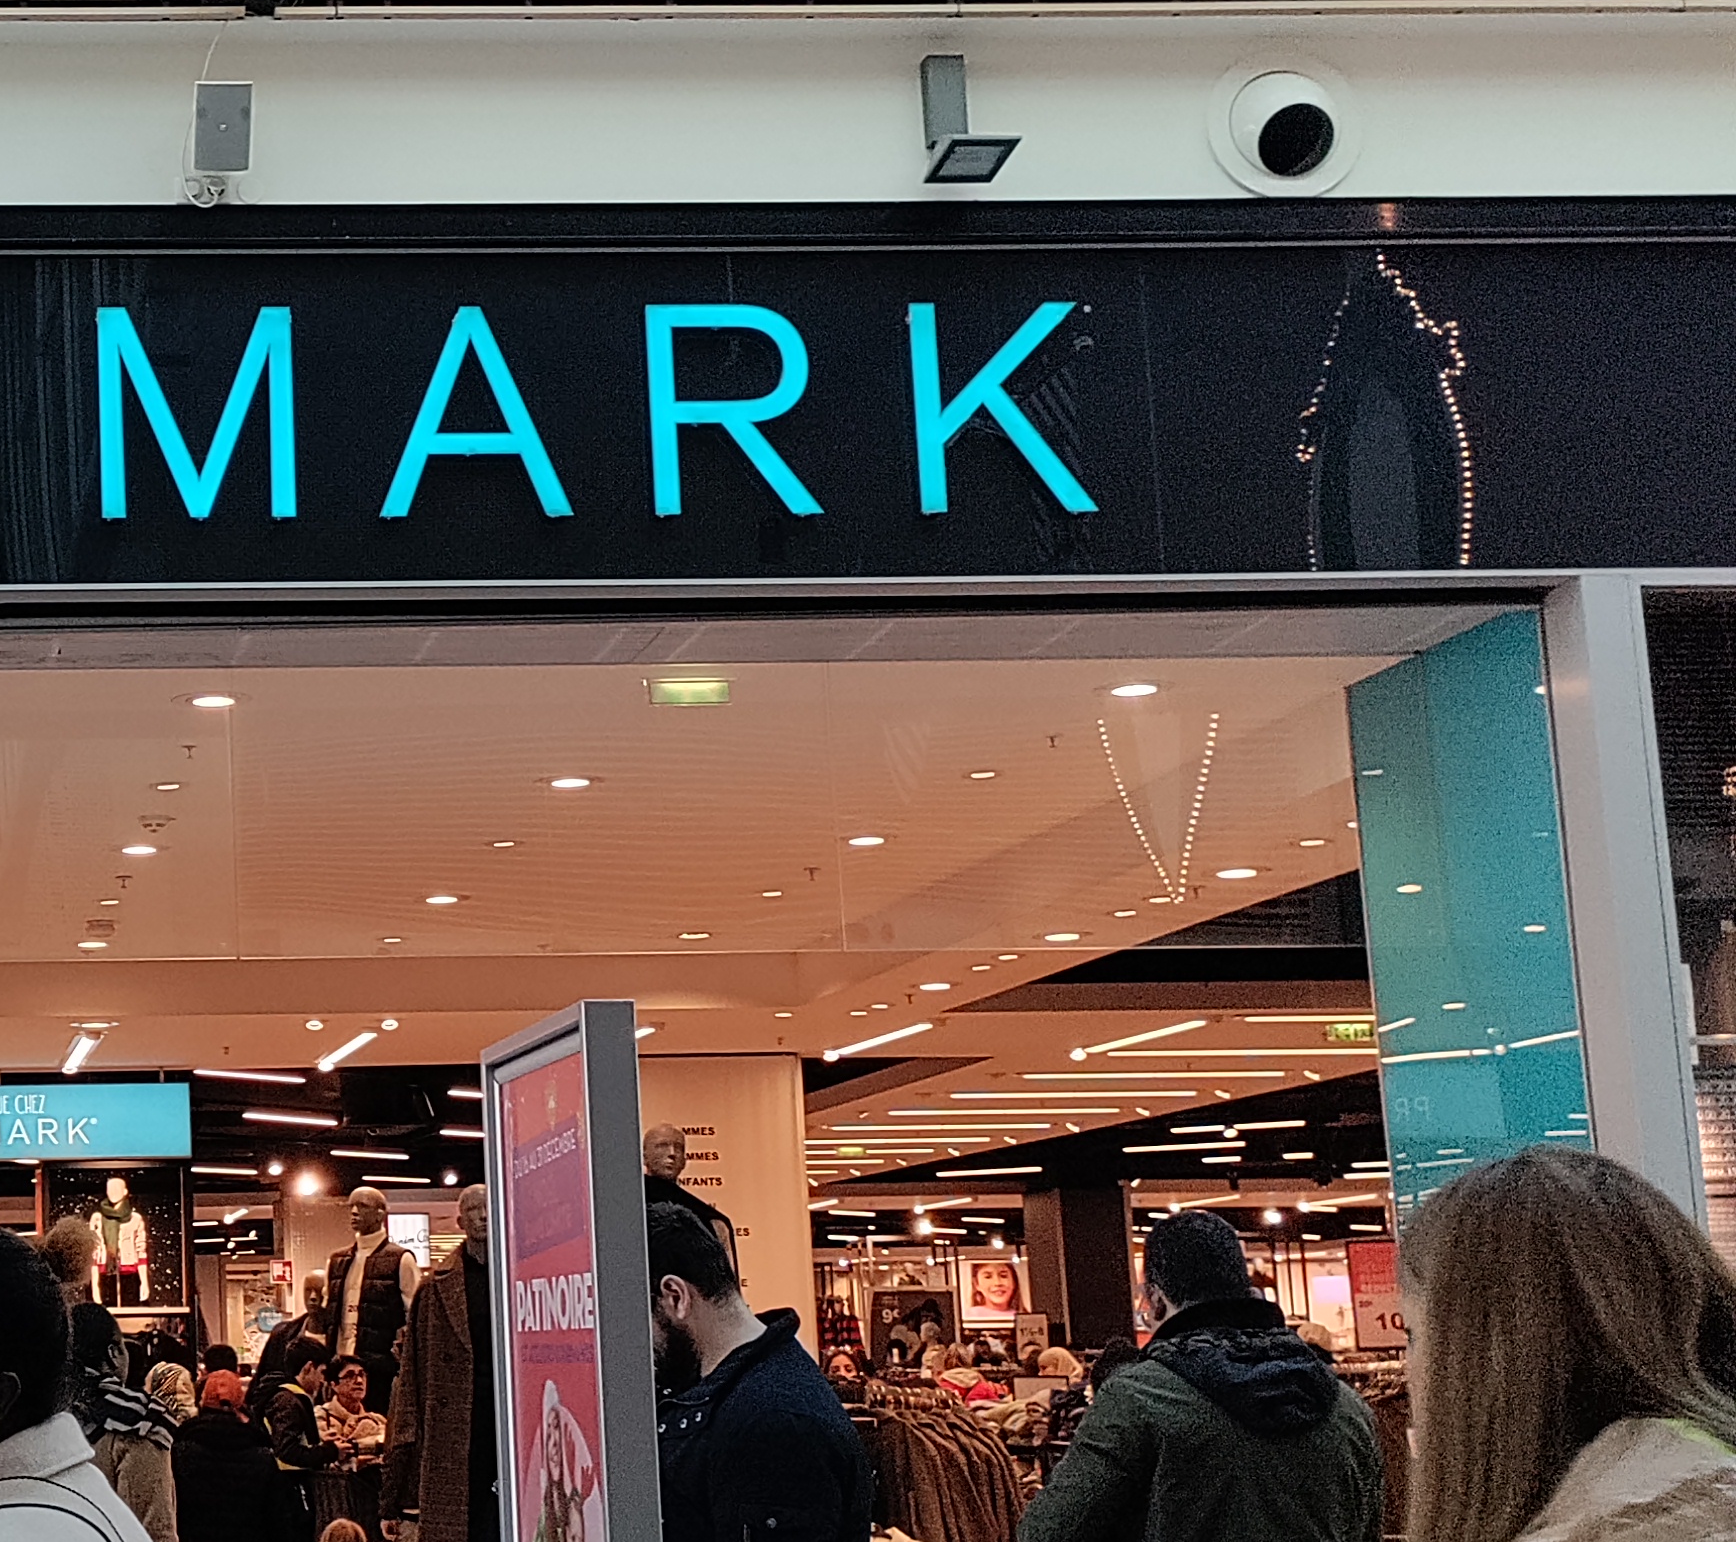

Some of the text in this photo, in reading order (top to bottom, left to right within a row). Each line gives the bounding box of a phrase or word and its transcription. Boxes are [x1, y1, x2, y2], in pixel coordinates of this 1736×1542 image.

[14, 1094, 46, 1114] CHEZ
[682, 1126, 716, 1136] MMES
[678, 1177, 723, 1186] NFANTS
[516, 1272, 595, 1332] PATINOIRE
